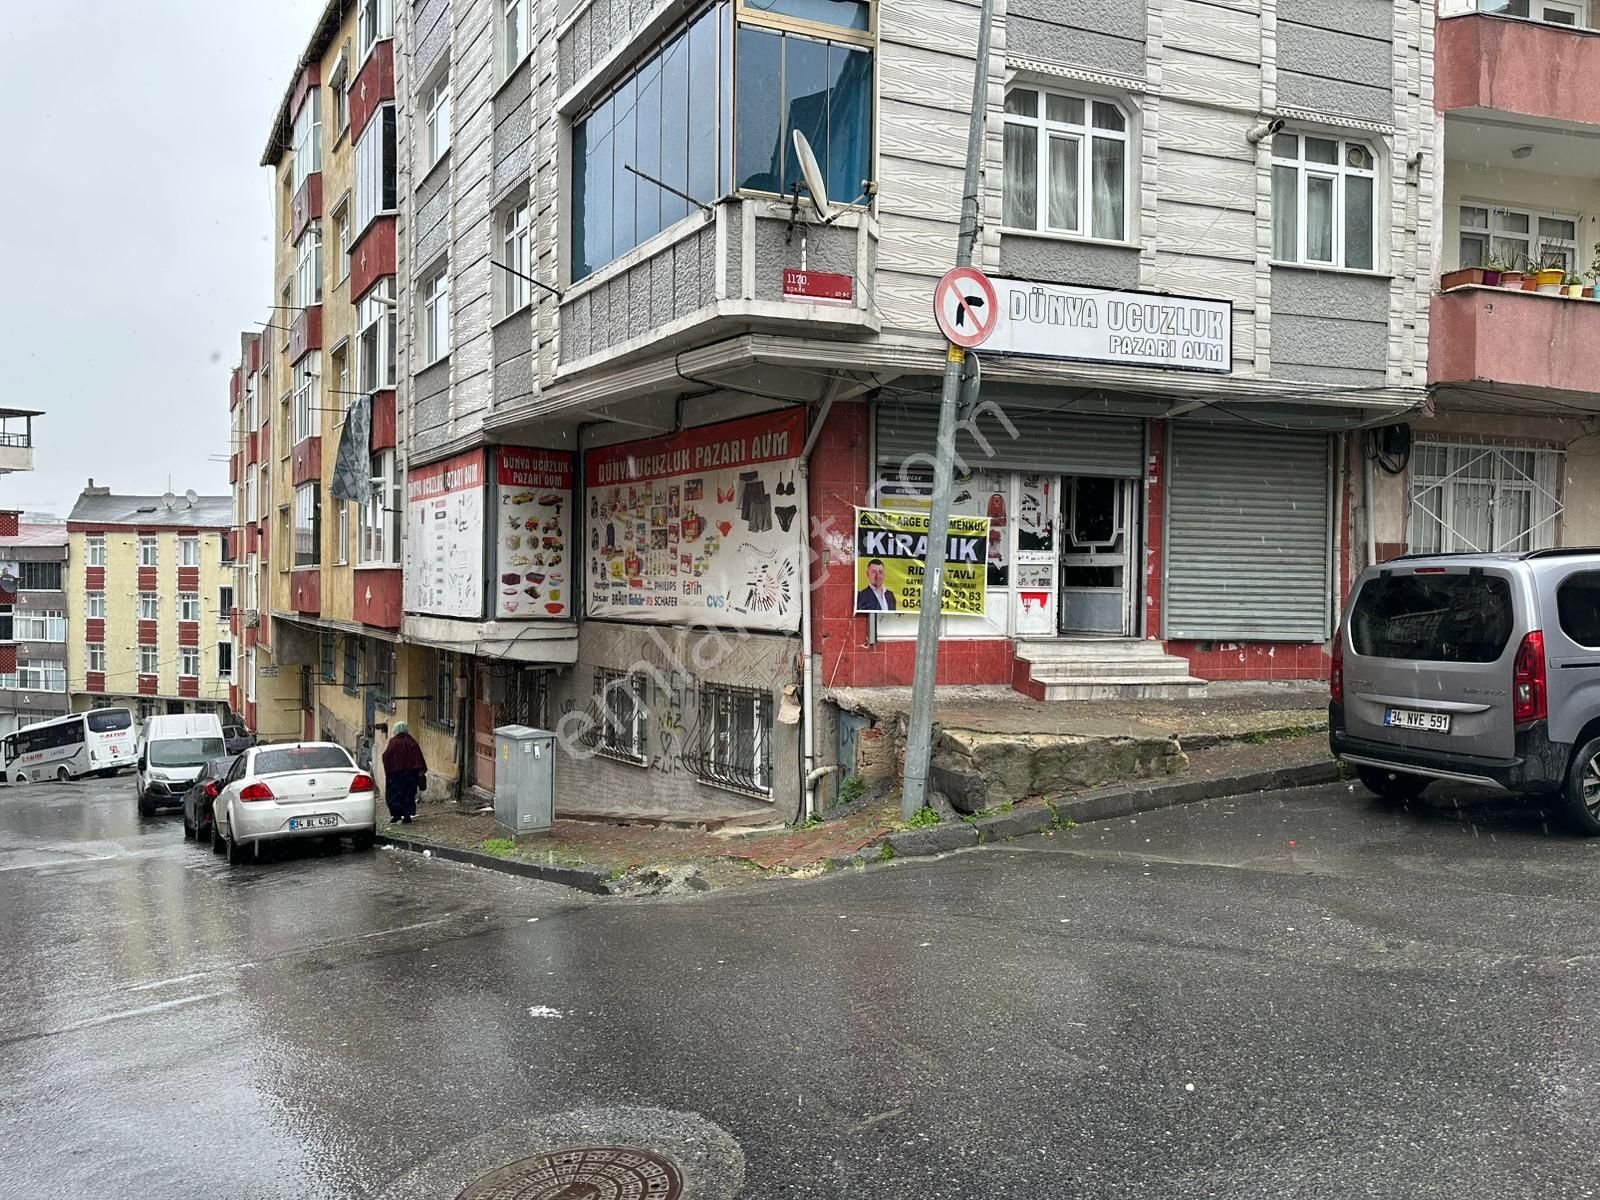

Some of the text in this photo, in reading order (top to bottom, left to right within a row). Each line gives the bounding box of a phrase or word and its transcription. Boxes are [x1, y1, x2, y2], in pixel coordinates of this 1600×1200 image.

[786, 273, 810, 286] 1170.
[1009, 286, 1223, 340] DÜNYA UCUZLUK
[1109, 335, 1223, 363] PAZARI AVM
[598, 430, 788, 483] DÜNYA UCUZLUK PAZARI AVM
[503, 456, 569, 473] DÜNYA UCUZLUK
[513, 471, 542, 486] PAZARI
[896, 516, 922, 527] ARGE
[866, 531, 978, 561] KiRAIK
[947, 569, 976, 580] TAVLI
[654, 581, 677, 591] PHILIPS
[706, 594, 725, 608] CVS
[902, 587, 922, 597] 021
[969, 591, 981, 601] 63
[902, 598, 922, 609] 054
[953, 600, 966, 609] 74
[1392, 711, 1402, 723] 34
[1407, 713, 1425, 726] NVE
[1430, 715, 1448, 729] 591
[306, 818, 314, 828] BL
